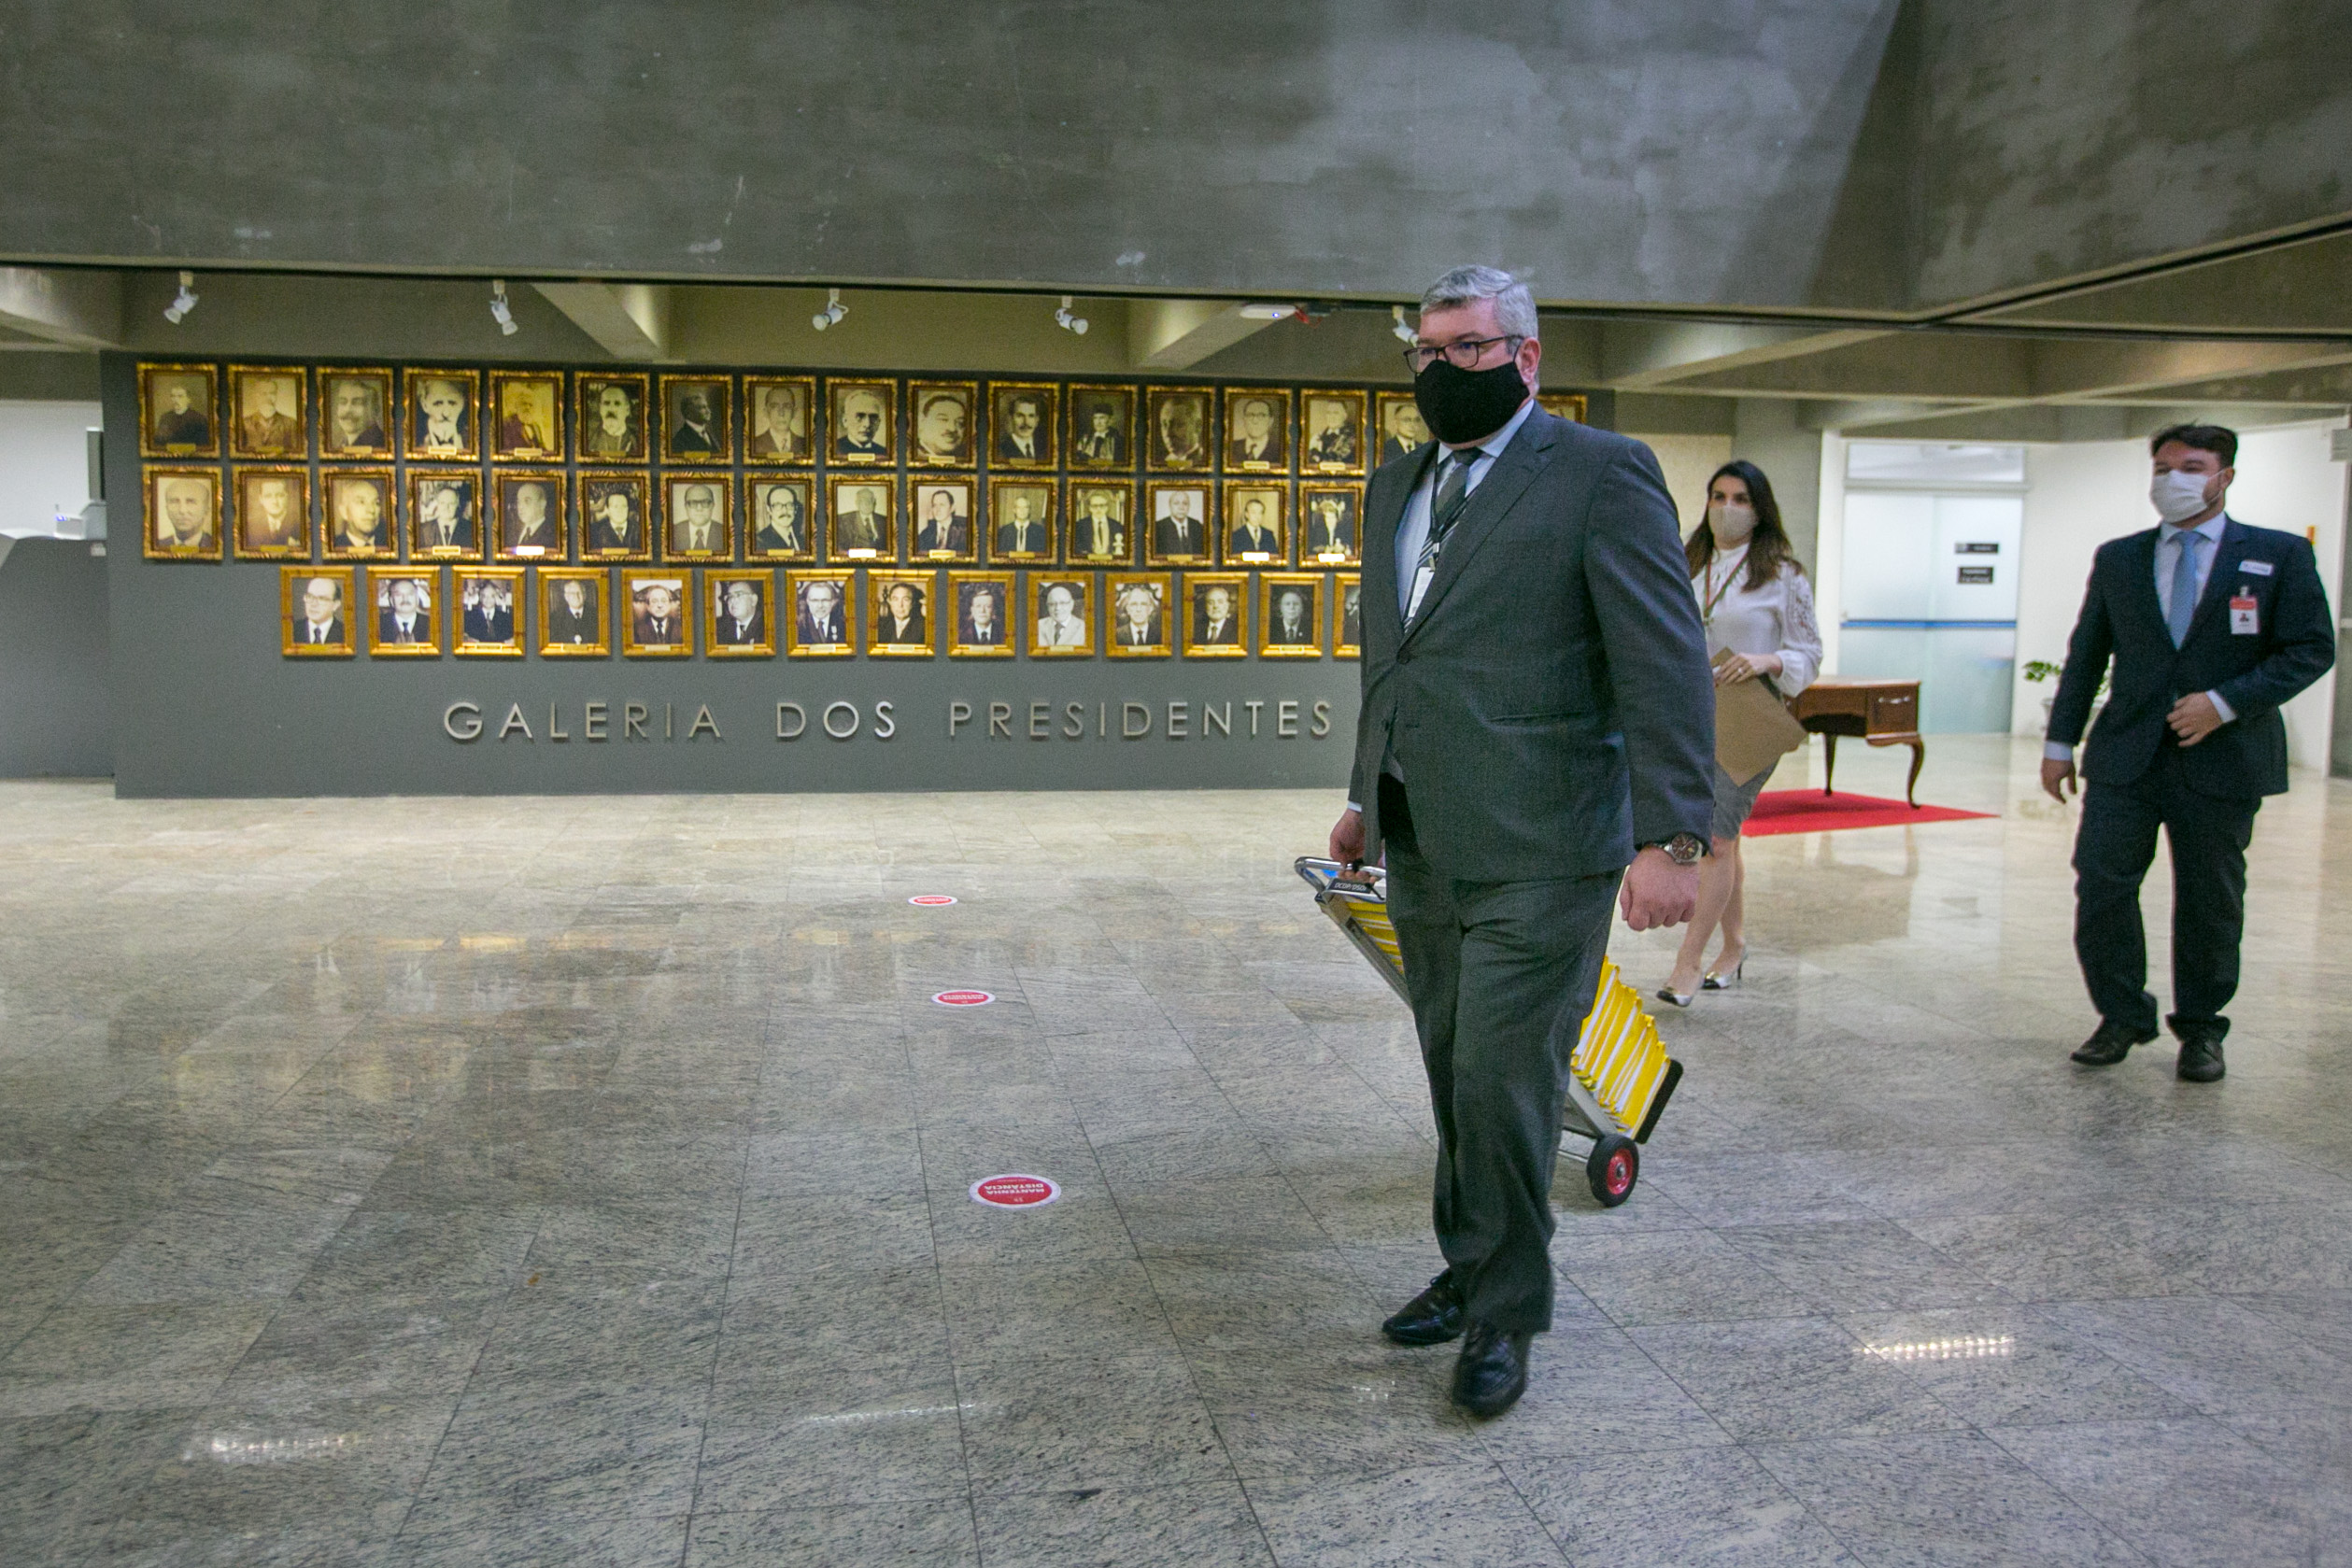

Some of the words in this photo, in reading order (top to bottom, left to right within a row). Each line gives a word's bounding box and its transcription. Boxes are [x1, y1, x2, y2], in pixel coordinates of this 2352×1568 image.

[444, 701, 722, 740] GALERIA
[776, 700, 897, 739] DOS
[950, 700, 1332, 736] PRESIDENTES
